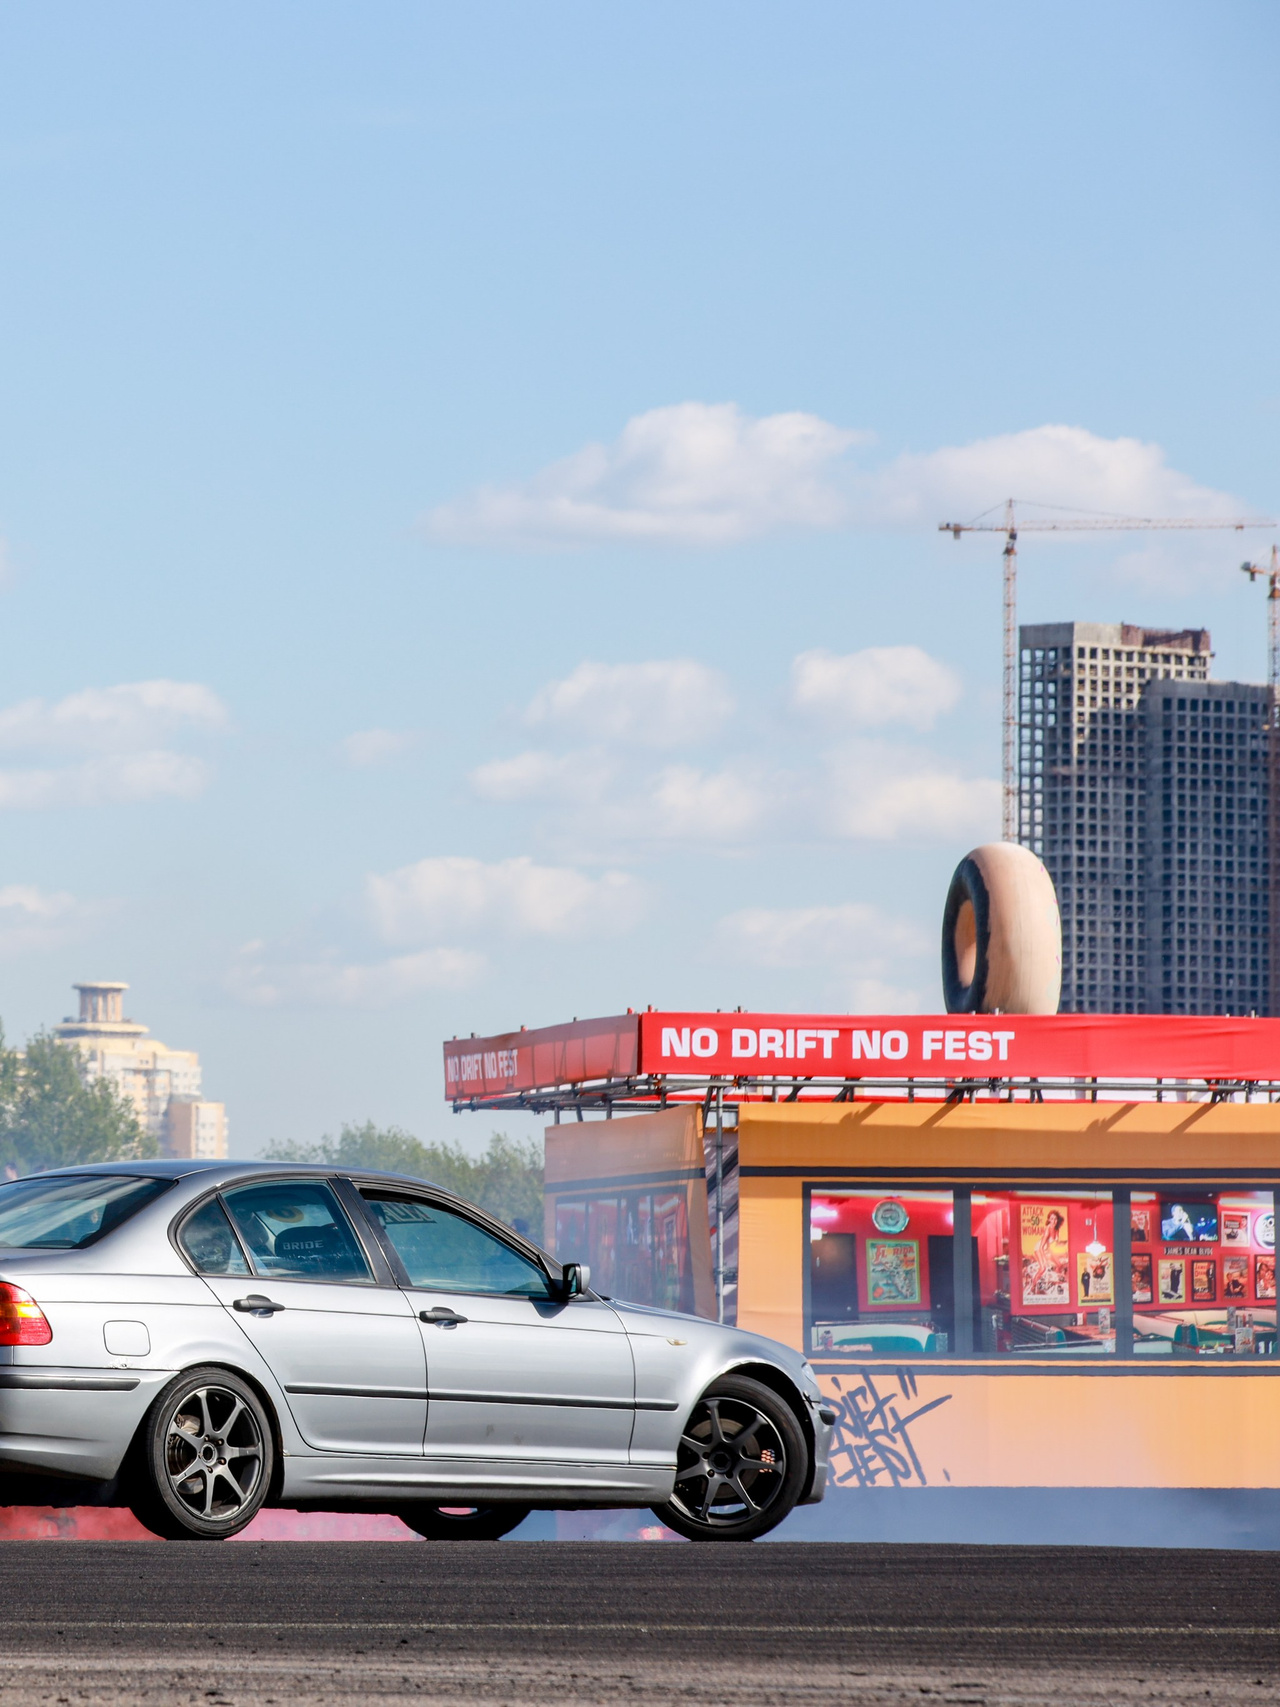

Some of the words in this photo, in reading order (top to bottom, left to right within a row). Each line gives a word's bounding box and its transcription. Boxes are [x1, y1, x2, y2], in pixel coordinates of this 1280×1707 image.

[661, 1027, 718, 1058] NO
[731, 1028, 840, 1059] DRIFT
[852, 1029, 909, 1060] NO
[922, 1030, 1015, 1061] FEST
[447, 1055, 460, 1082] NO
[460, 1053, 483, 1081] DRIFT
[484, 1051, 498, 1079] NO
[497, 1049, 519, 1078] FEST
[282, 1239, 324, 1250] BRIDE
